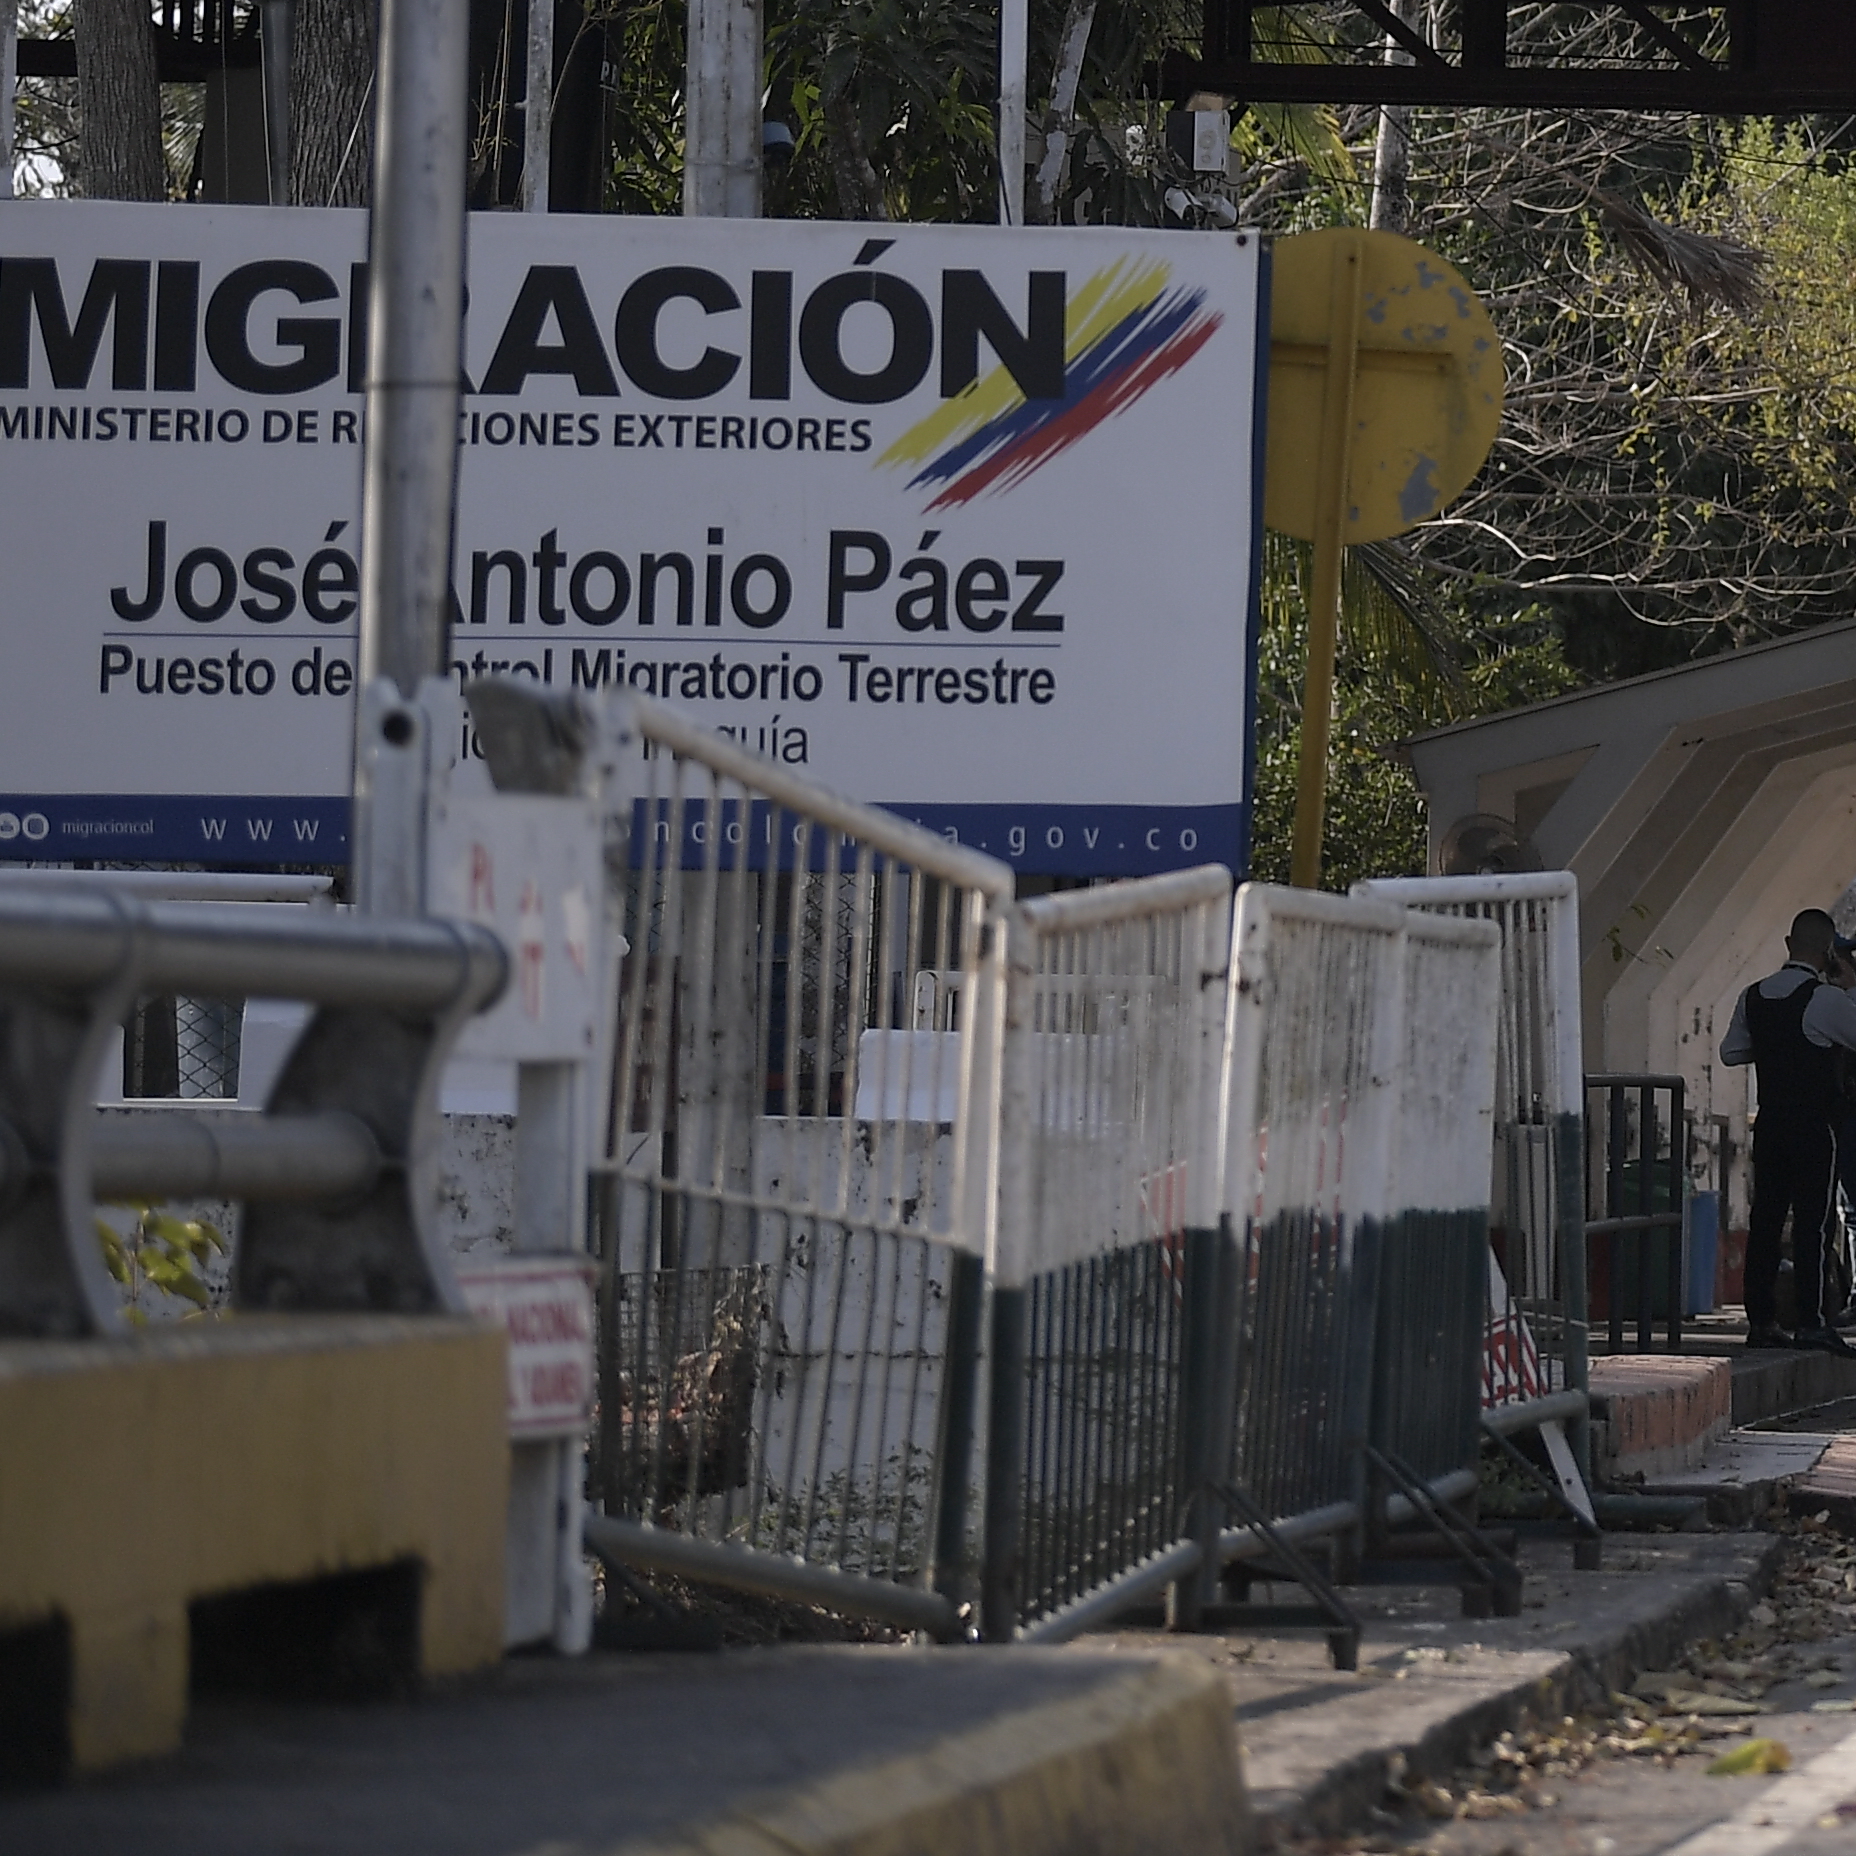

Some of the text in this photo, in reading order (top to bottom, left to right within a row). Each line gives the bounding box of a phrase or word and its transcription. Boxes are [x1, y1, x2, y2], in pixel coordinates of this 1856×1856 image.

[0, 239, 1068, 405] MIGACIÓN
[0, 407, 250, 444] MINISTERIO
[262, 409, 318, 444] DE
[614, 413, 873, 453] EXTERIORES
[109, 519, 1066, 632] José ntonio Páez
[100, 644, 277, 696] Puesto
[291, 647, 354, 697] de
[838, 653, 1056, 705] Terrestre
[62, 817, 155, 843] migracioncol
